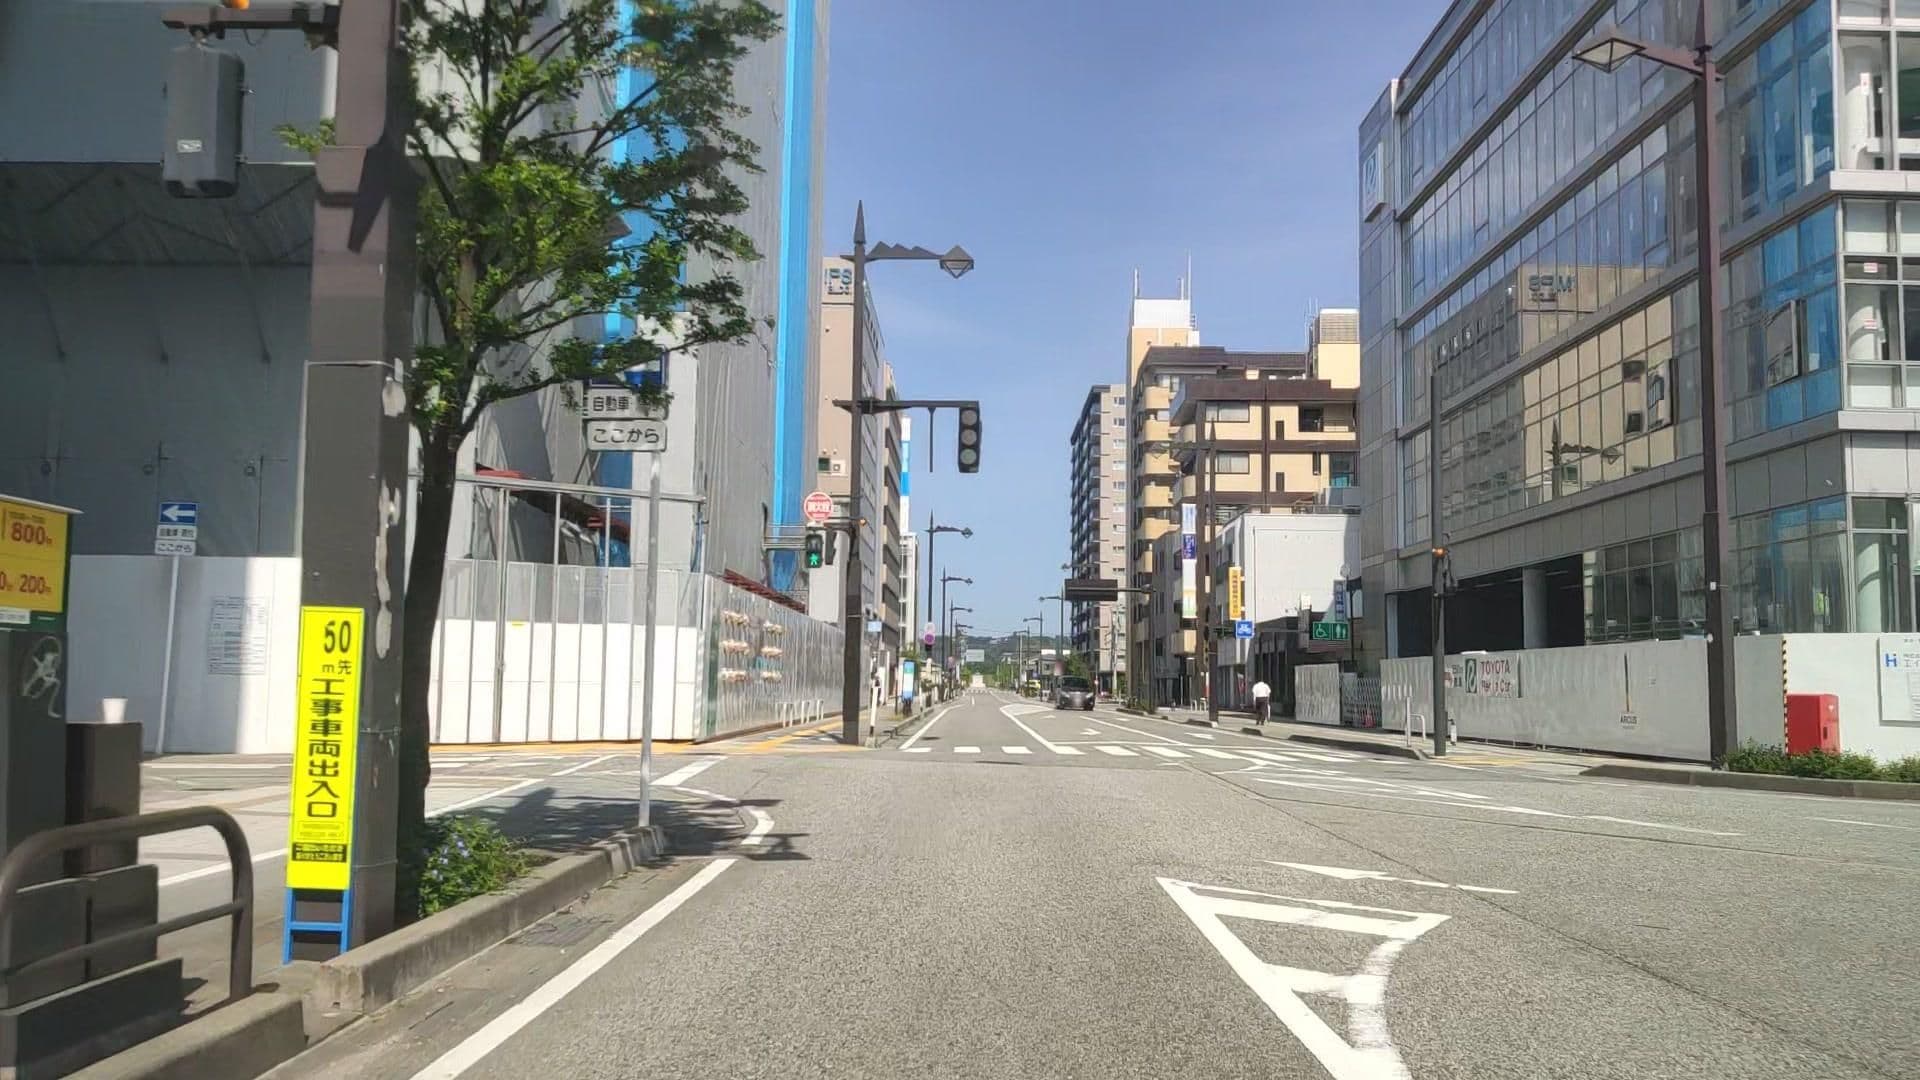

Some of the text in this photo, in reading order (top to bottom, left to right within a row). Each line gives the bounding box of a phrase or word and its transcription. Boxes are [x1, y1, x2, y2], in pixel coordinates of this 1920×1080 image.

[593, 427, 660, 444] ここから
[324, 620, 352, 653] 50
[1480, 660, 1511, 675] TOYOTA
[306, 678, 345, 818] 工事車両出入口
